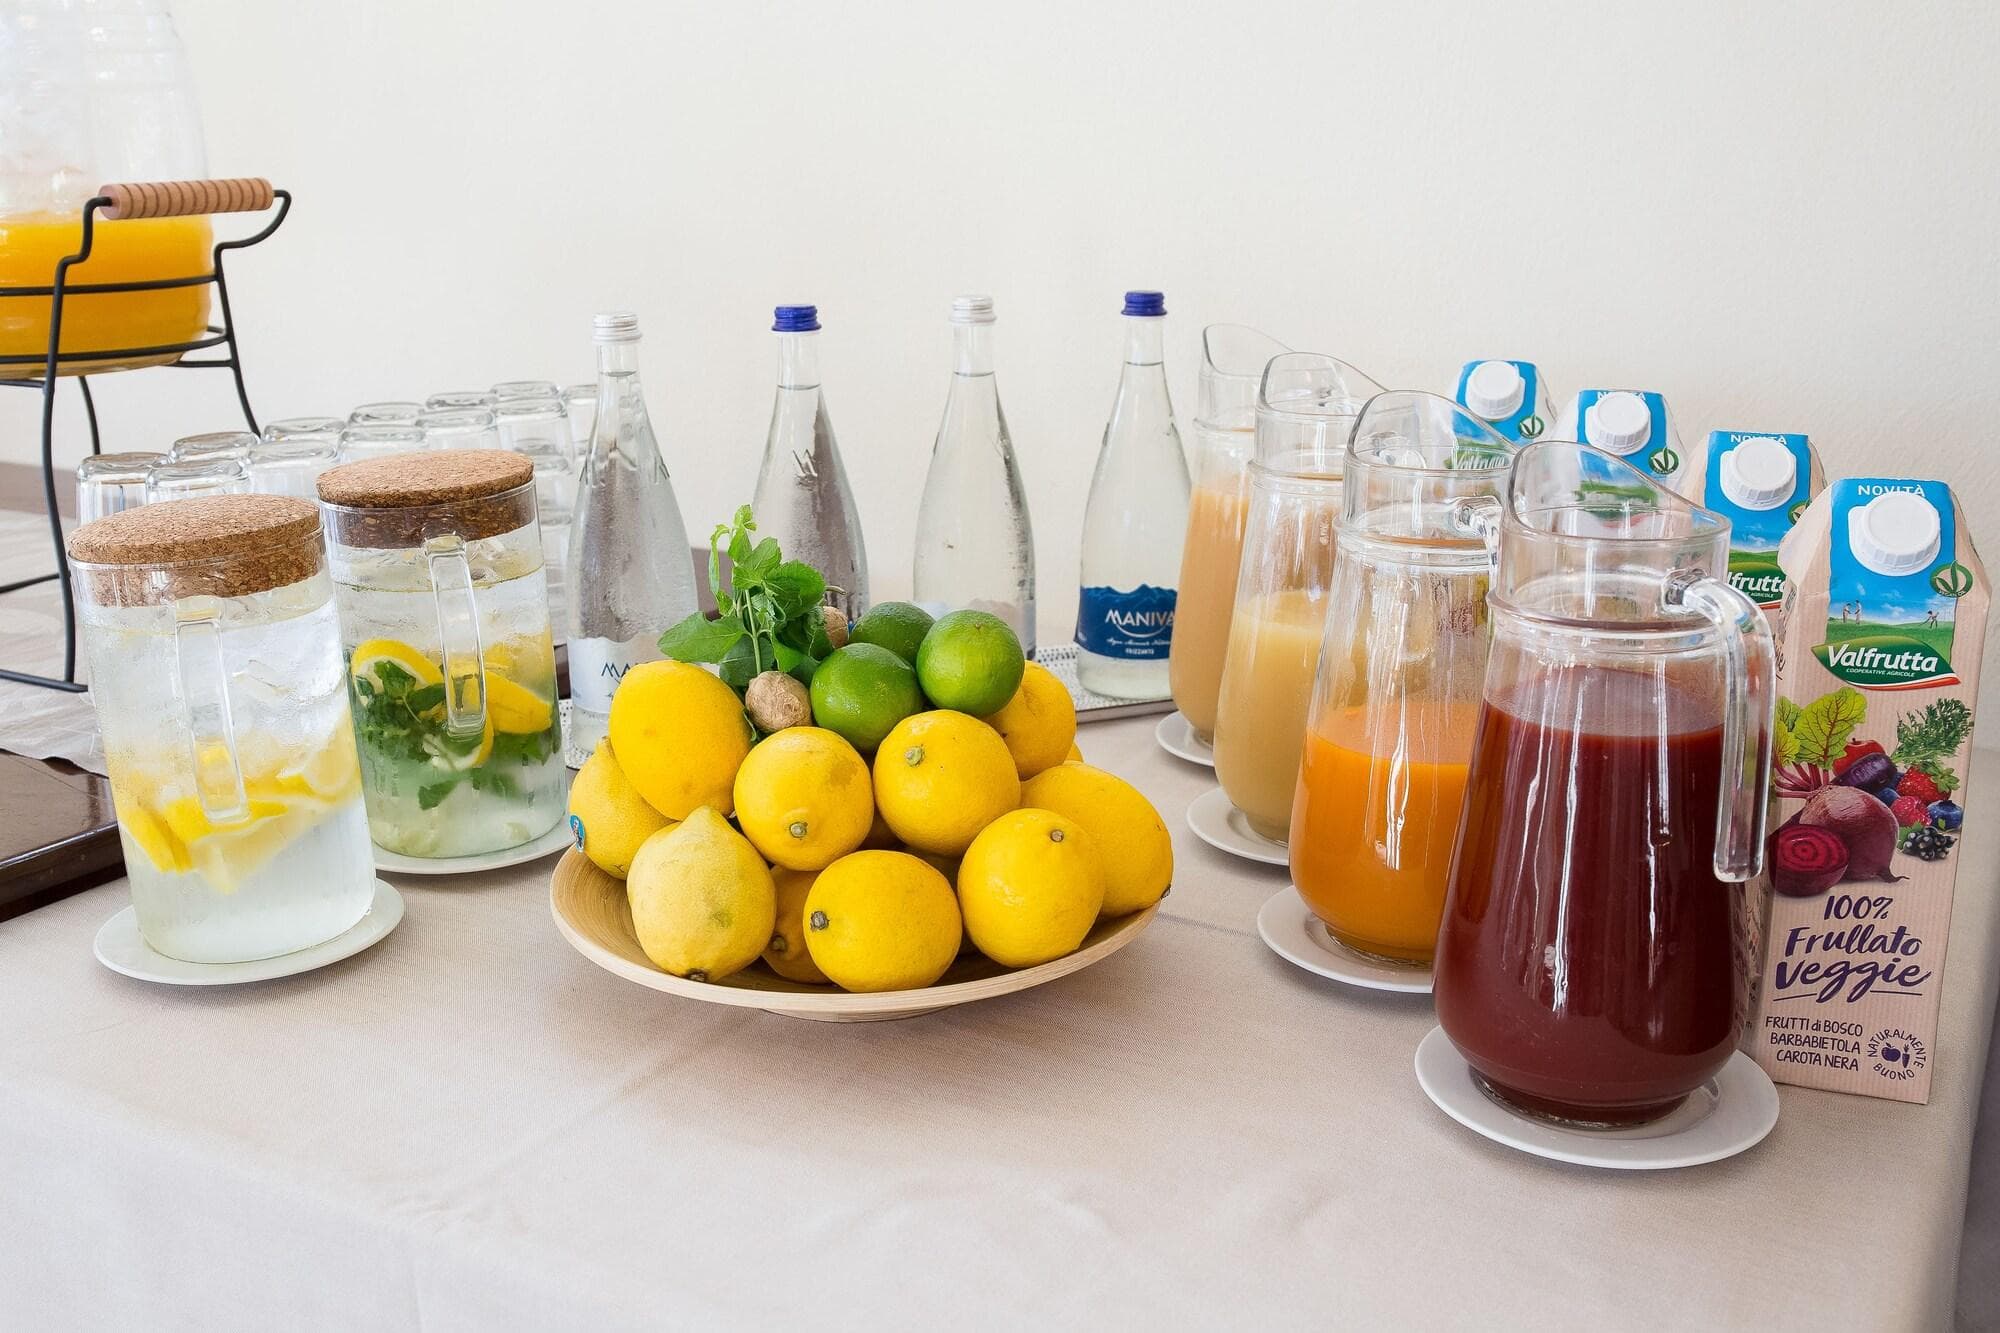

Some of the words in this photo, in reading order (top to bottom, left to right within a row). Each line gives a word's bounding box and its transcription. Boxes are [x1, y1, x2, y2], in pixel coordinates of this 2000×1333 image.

[1827, 643, 1938, 673] Valfrutta
[1845, 668, 1885, 676] COOPERATIVE
[1886, 670, 1915, 678] AGRICOLE
[1823, 894, 1893, 921] 100%
[1784, 923, 1923, 958] Frullato
[1765, 1015, 1810, 1031] FRUTTI
[1811, 1019, 1822, 1032] di
[1823, 1019, 1863, 1037] BOSCO
[1770, 1032, 1861, 1055] BARBABIETOLA
[1867, 1028, 1927, 1069] NATURALMENTE
[1776, 1049, 1822, 1066] CAROTA
[1824, 1054, 1859, 1072] NERA
[1873, 1062, 1915, 1081] BUONO
